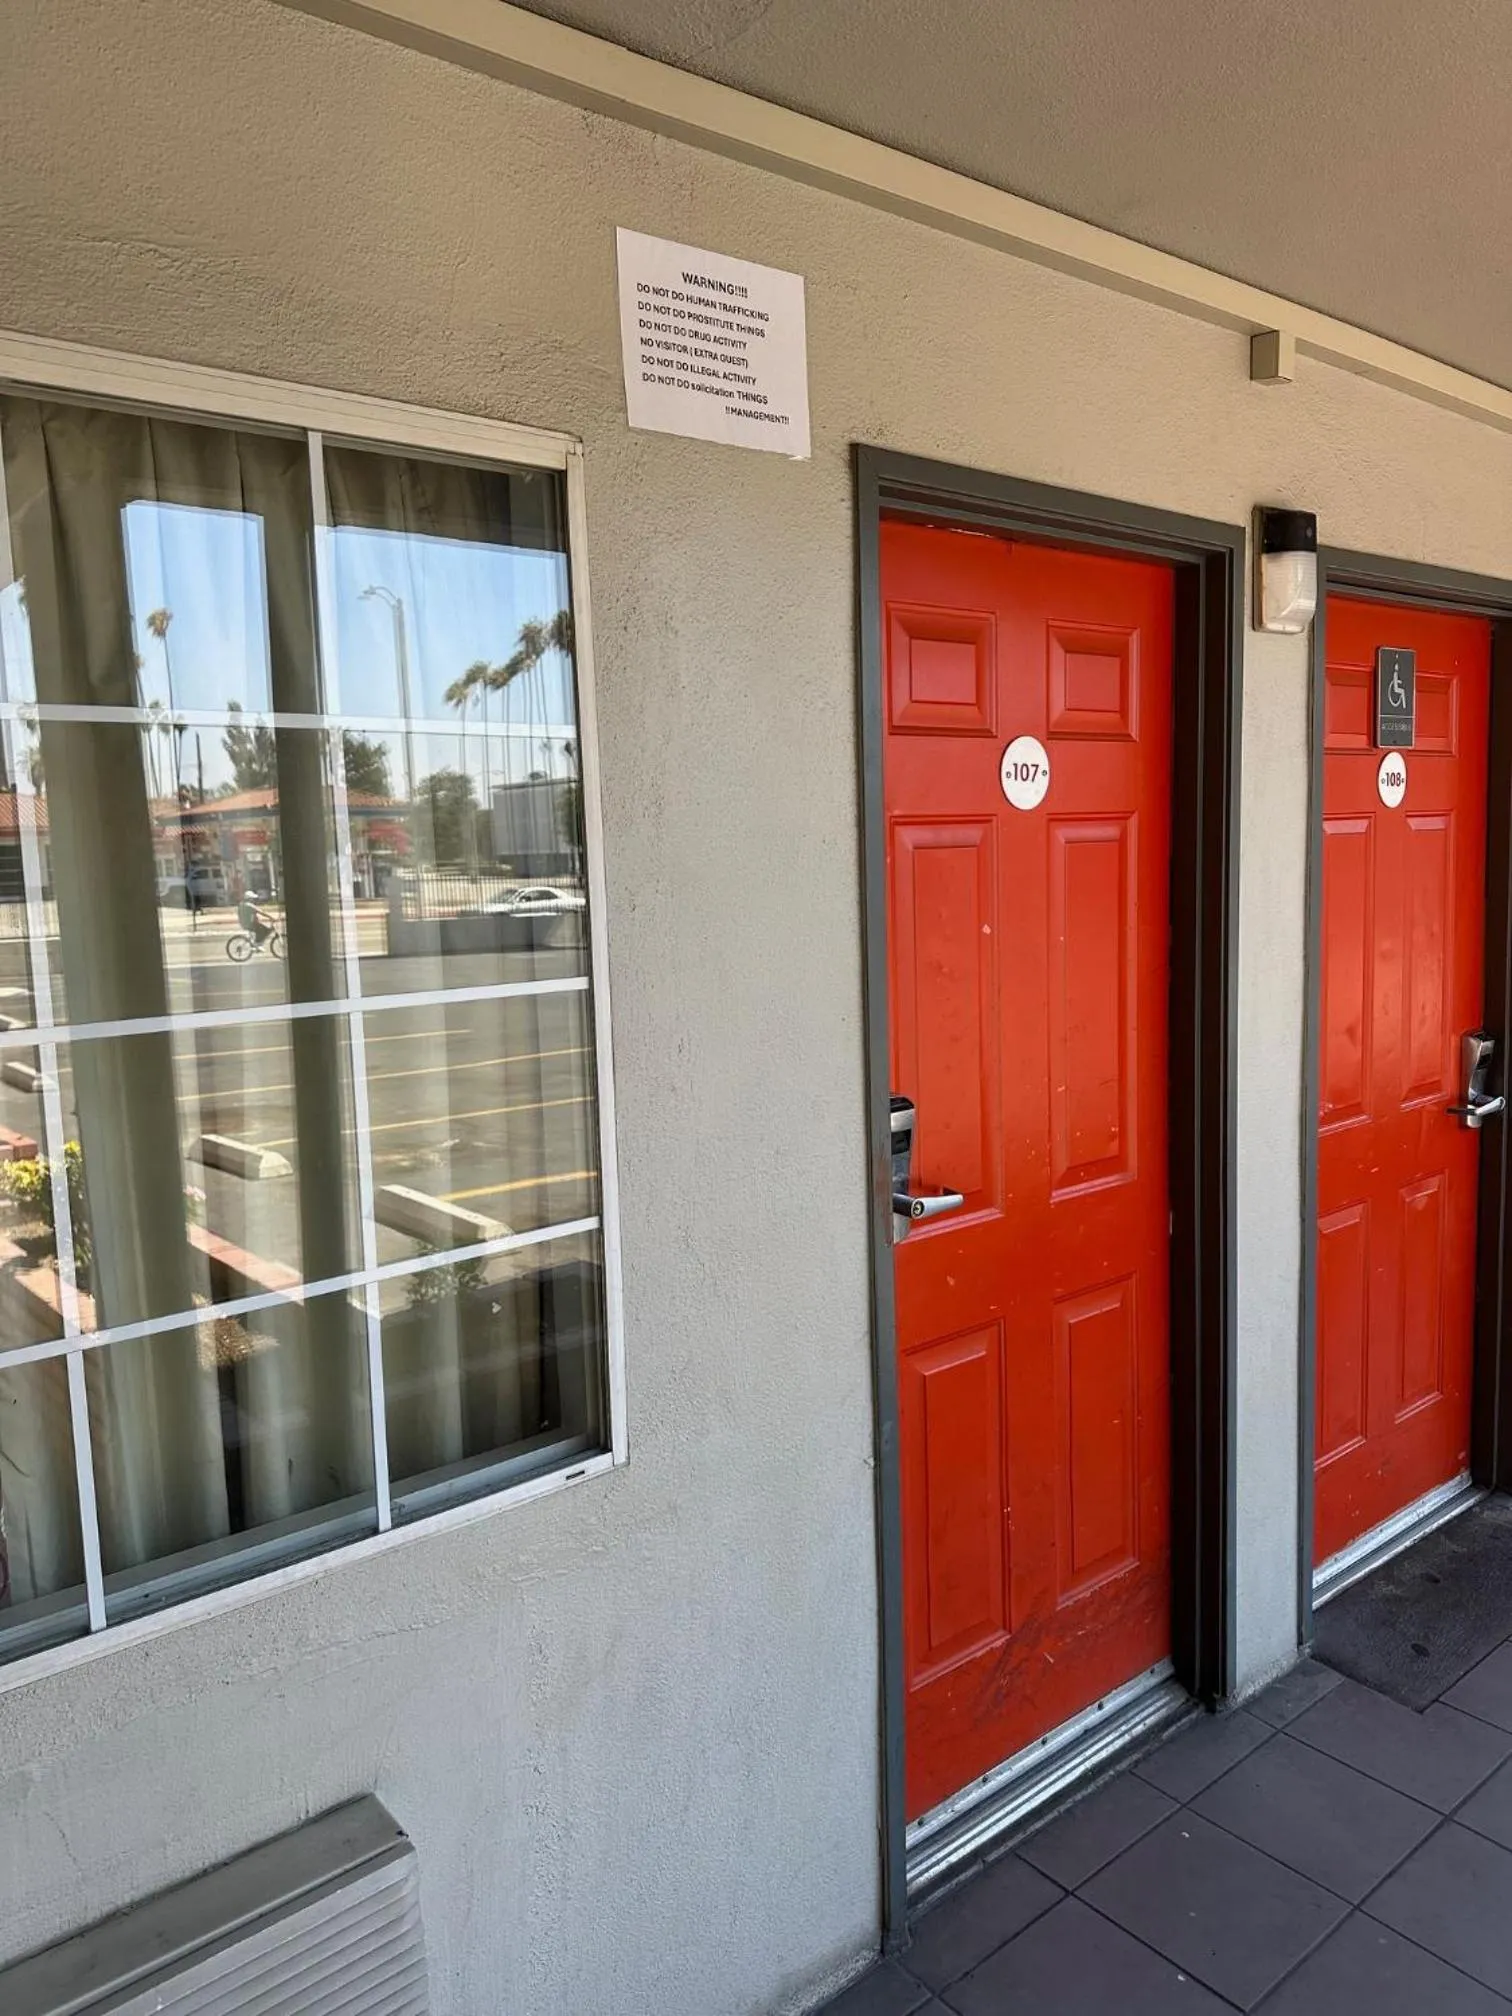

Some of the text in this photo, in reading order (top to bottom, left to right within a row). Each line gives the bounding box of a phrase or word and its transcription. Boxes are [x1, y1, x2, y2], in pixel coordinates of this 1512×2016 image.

[681, 271, 748, 299] WARNING!!!!
[636, 282, 770, 322] DO NOT DO HUMAN TRAFFICKING
[637, 300, 766, 338] DO NOT DO PROSTITUTE THINGS
[639, 318, 748, 350] DO NOT DO DRUG ACTIVITY
[640, 336, 654, 348] NO
[655, 339, 689, 354] VISITOR
[641, 354, 757, 386] DO NOT DO ILLEGAL ACTIVITY
[642, 372, 769, 405] DO NOT DO solicitation THINGS
[1013, 762, 1040, 783] 107
[1385, 772, 1402, 787] 108
